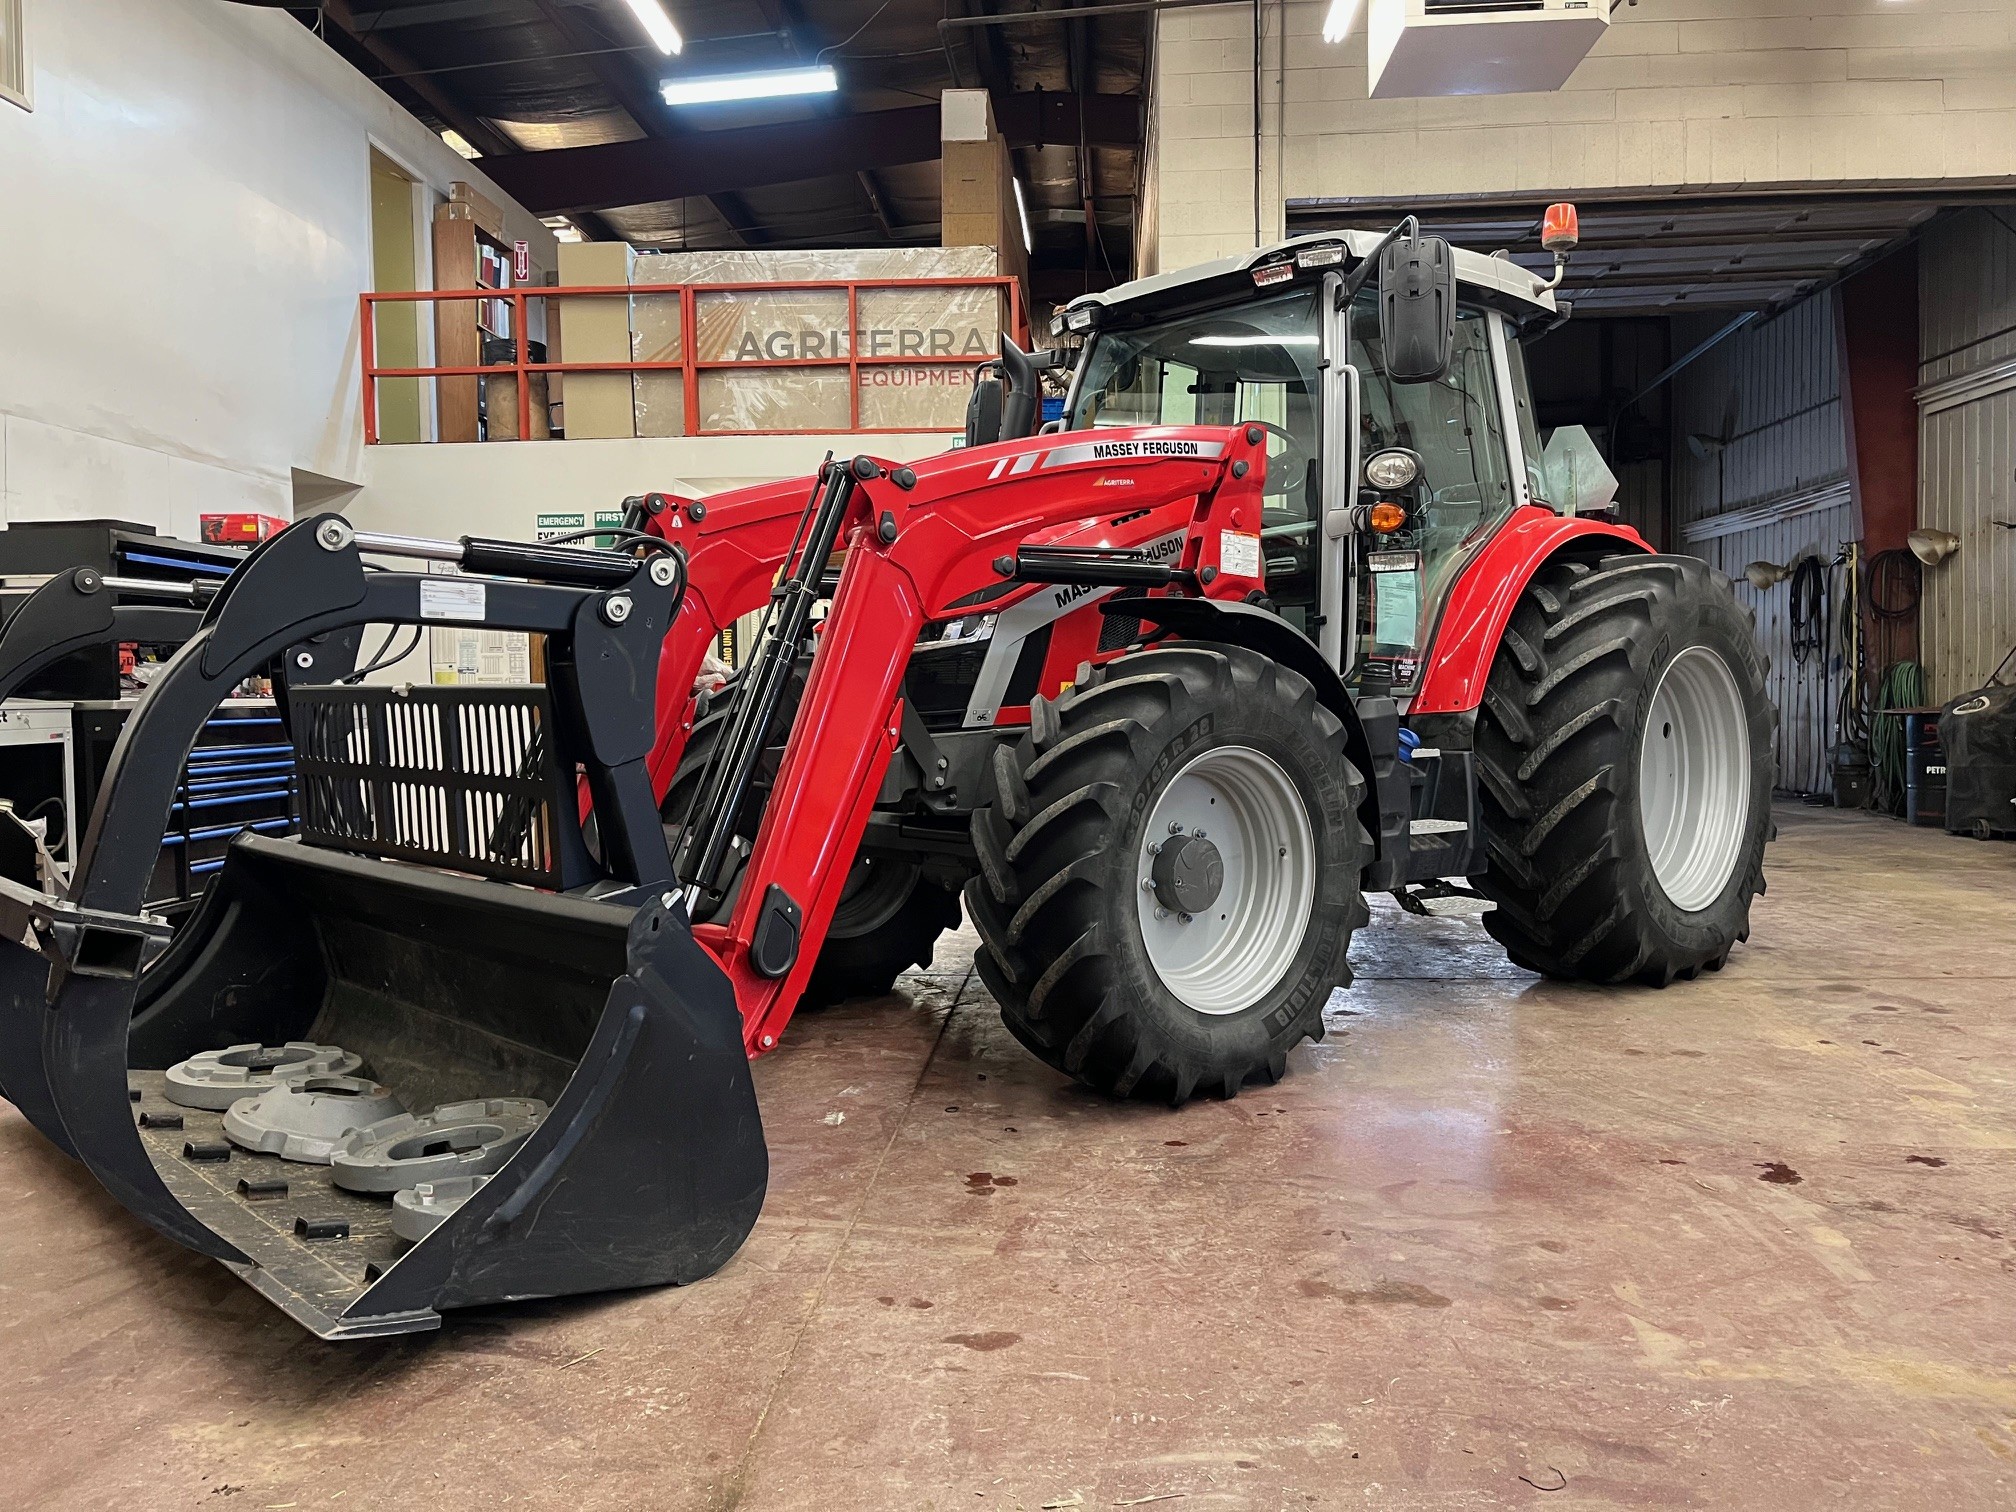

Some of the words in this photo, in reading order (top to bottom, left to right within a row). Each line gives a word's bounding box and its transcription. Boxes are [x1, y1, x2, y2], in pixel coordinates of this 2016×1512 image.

[735, 328, 989, 361] AGRITERRA
[858, 369, 992, 387] EQUIPMENT
[1094, 443, 1139, 459] MASSEY
[1143, 442, 1198, 455] FERGUSON
[1103, 478, 1135, 487] AGRITERRA
[538, 516, 584, 526] EMERGENCY
[596, 513, 624, 522] FIRST
[723, 647, 733, 666] EMO
